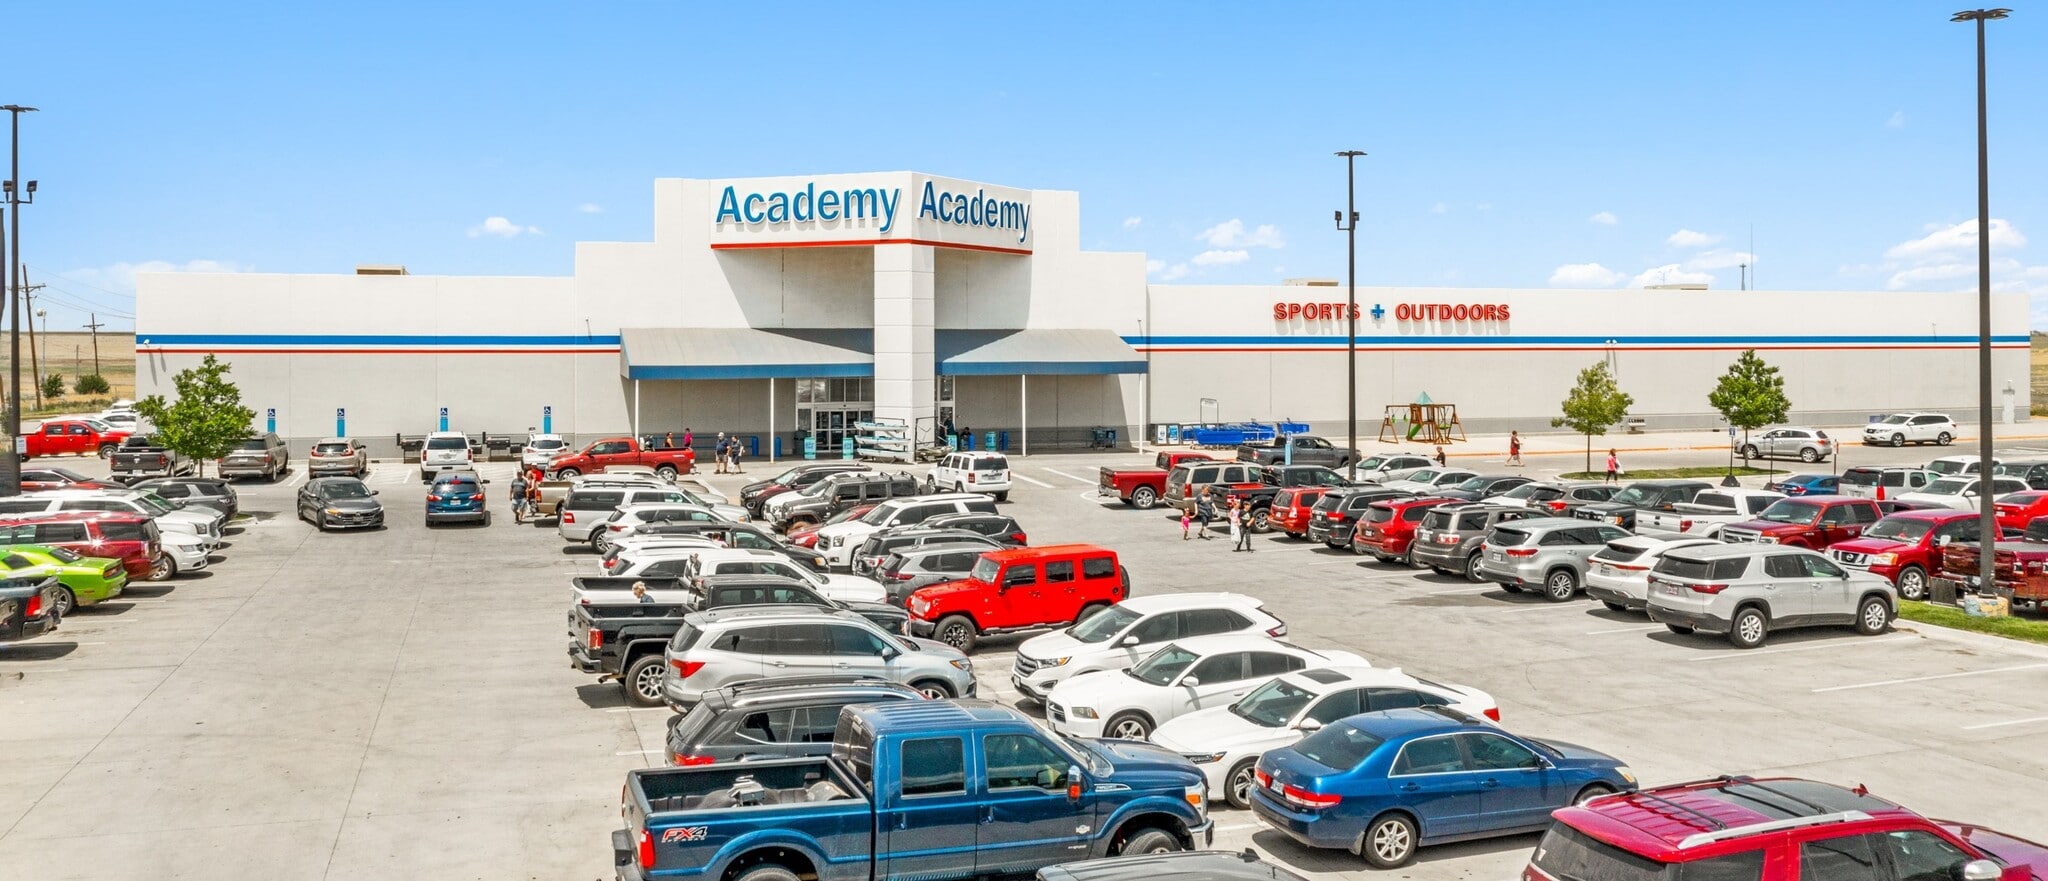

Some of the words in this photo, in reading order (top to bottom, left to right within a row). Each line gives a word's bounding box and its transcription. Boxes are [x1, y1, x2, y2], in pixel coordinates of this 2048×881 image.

[716, 182, 900, 233] Academy
[919, 180, 1031, 243] Academy
[1273, 302, 1360, 320] SPORTS
[1395, 303, 1510, 321] OUTDOORS
[662, 826, 708, 841] FX4
